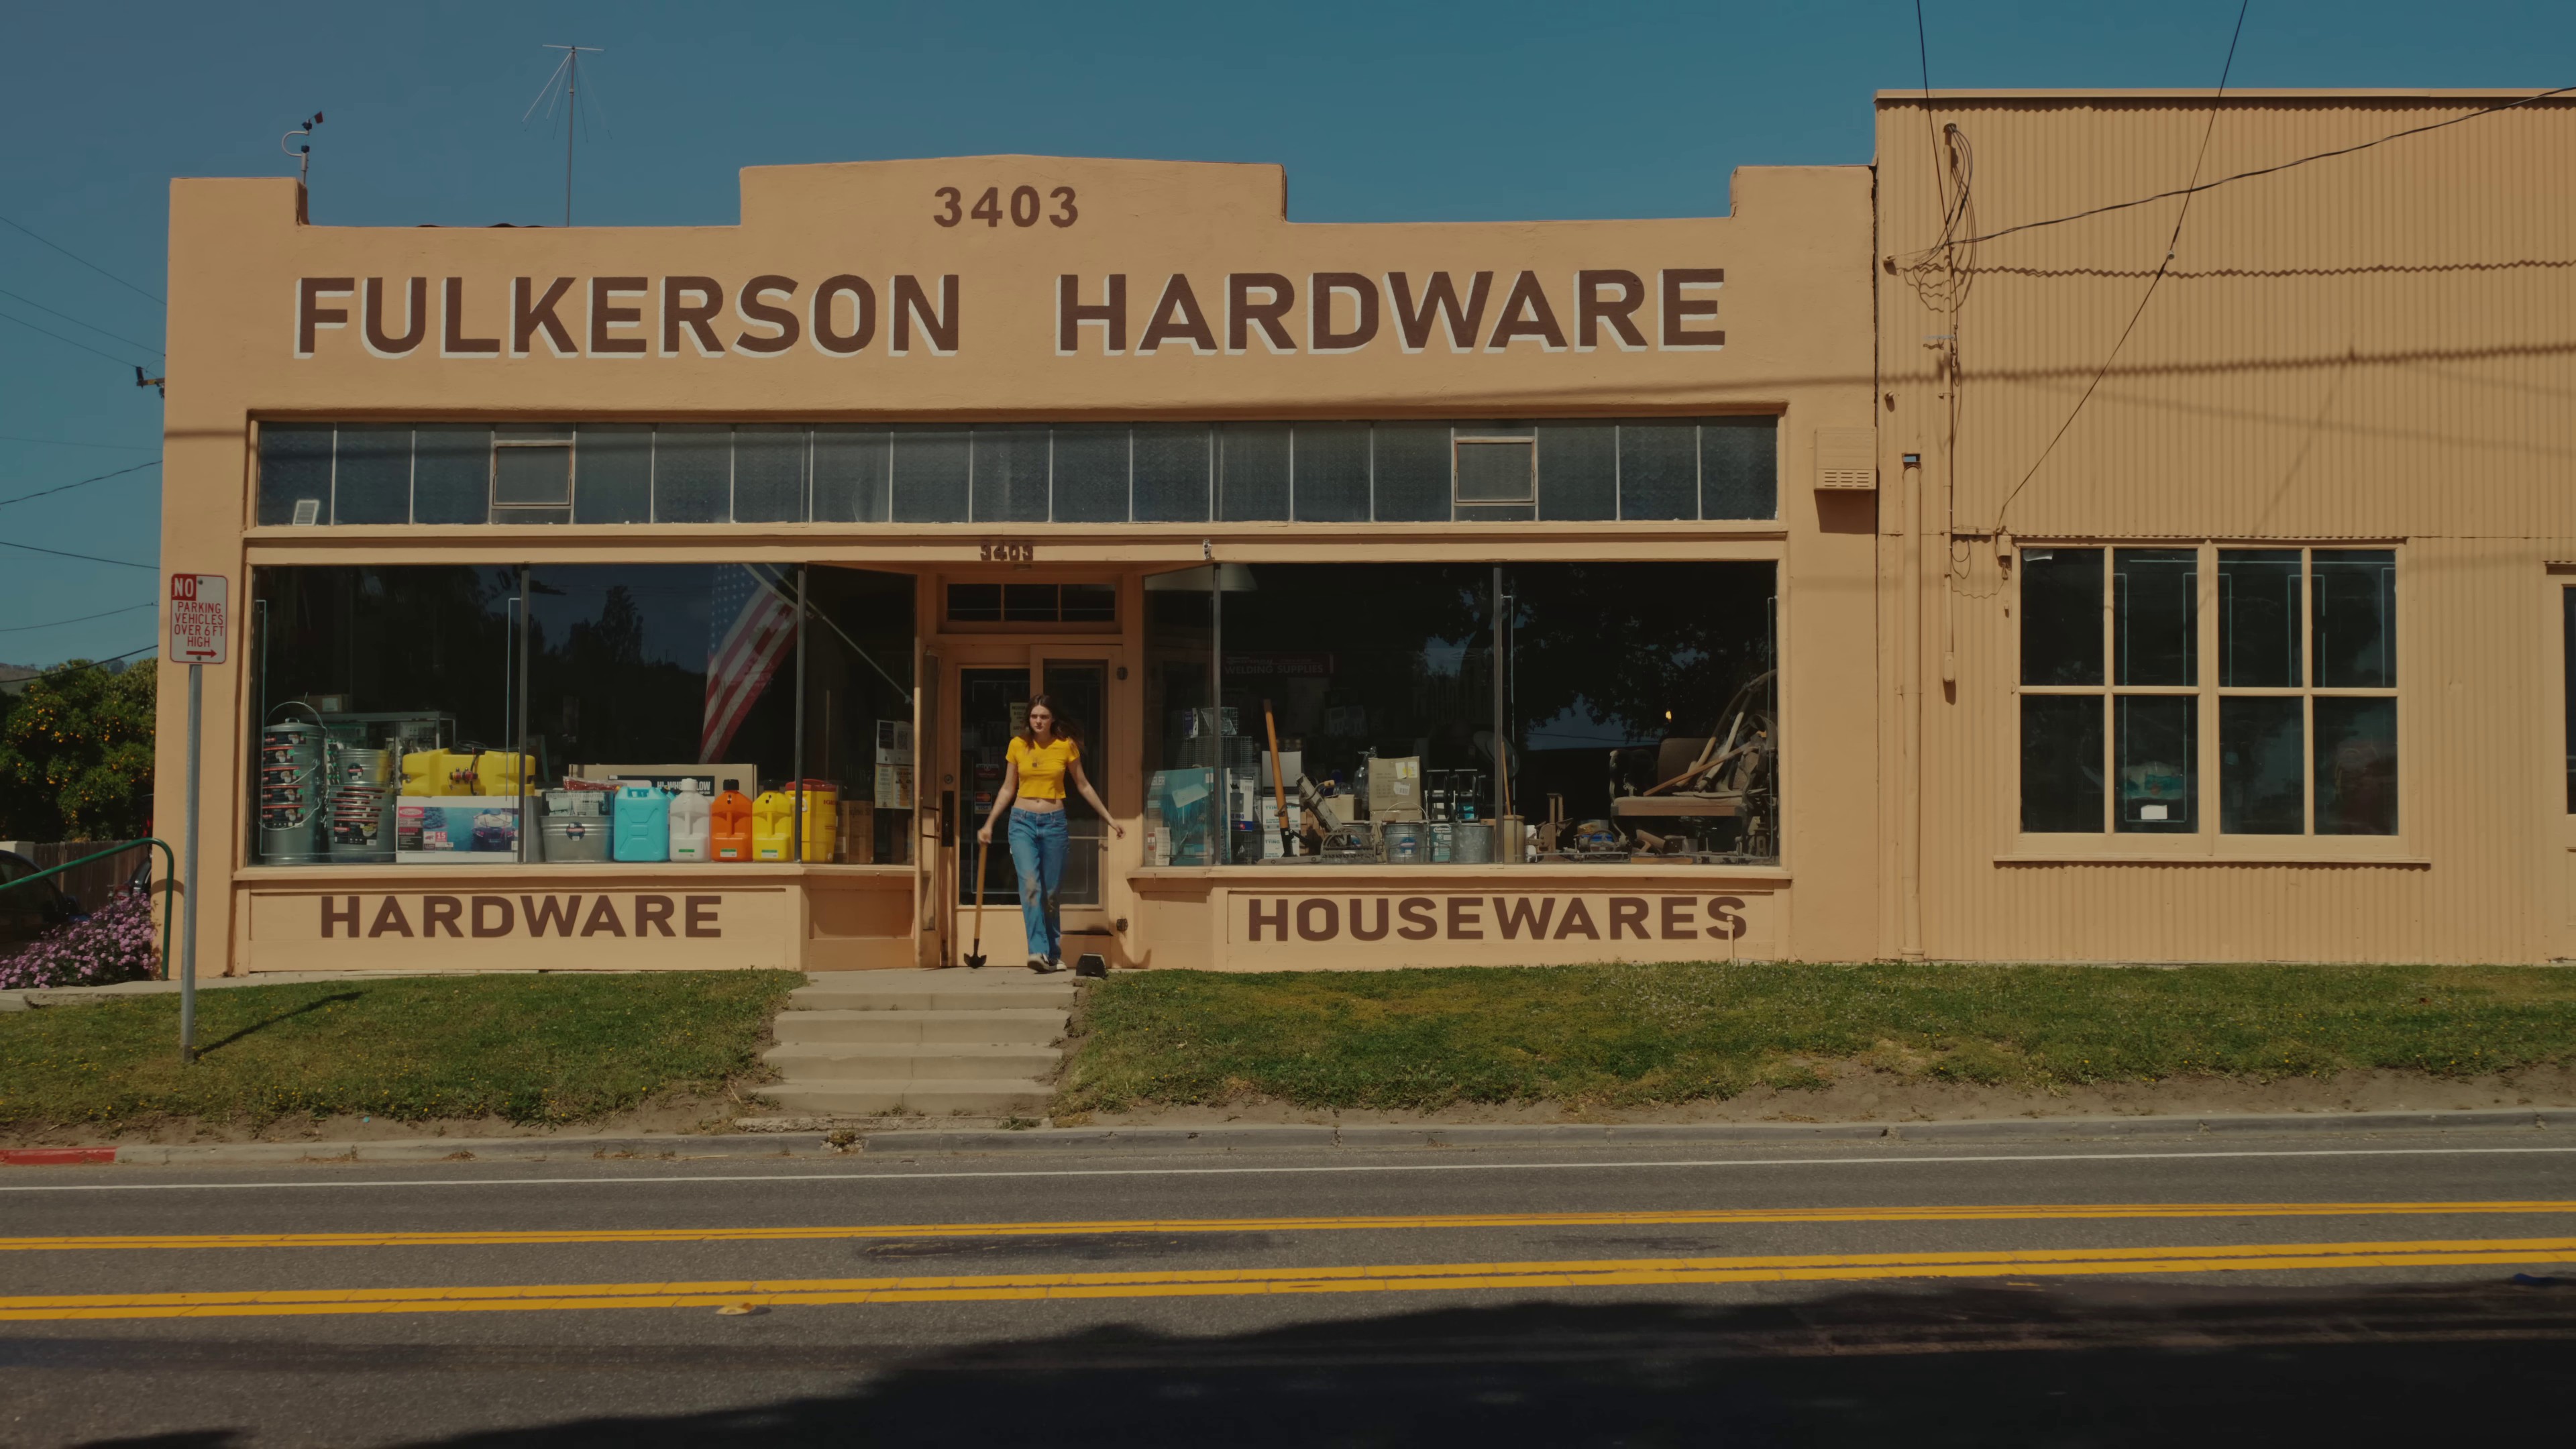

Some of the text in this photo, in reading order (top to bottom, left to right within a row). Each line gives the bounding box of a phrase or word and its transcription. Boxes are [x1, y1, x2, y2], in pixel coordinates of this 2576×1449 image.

[934, 185, 1078, 228] 3403
[299, 268, 1725, 354] FULKERSON HARDWARE
[980, 539, 1034, 561] 3403
[174, 577, 194, 598] NO
[177, 601, 221, 614] PARKING
[174, 612, 224, 625] VEHICLES
[174, 624, 224, 637] OVER 6 FT
[187, 635, 211, 647] HIGH
[1224, 664, 1324, 675] WELDING SUPPLIES
[321, 895, 722, 938] HARDWARE
[1248, 896, 1747, 942] HOUSEWARES
